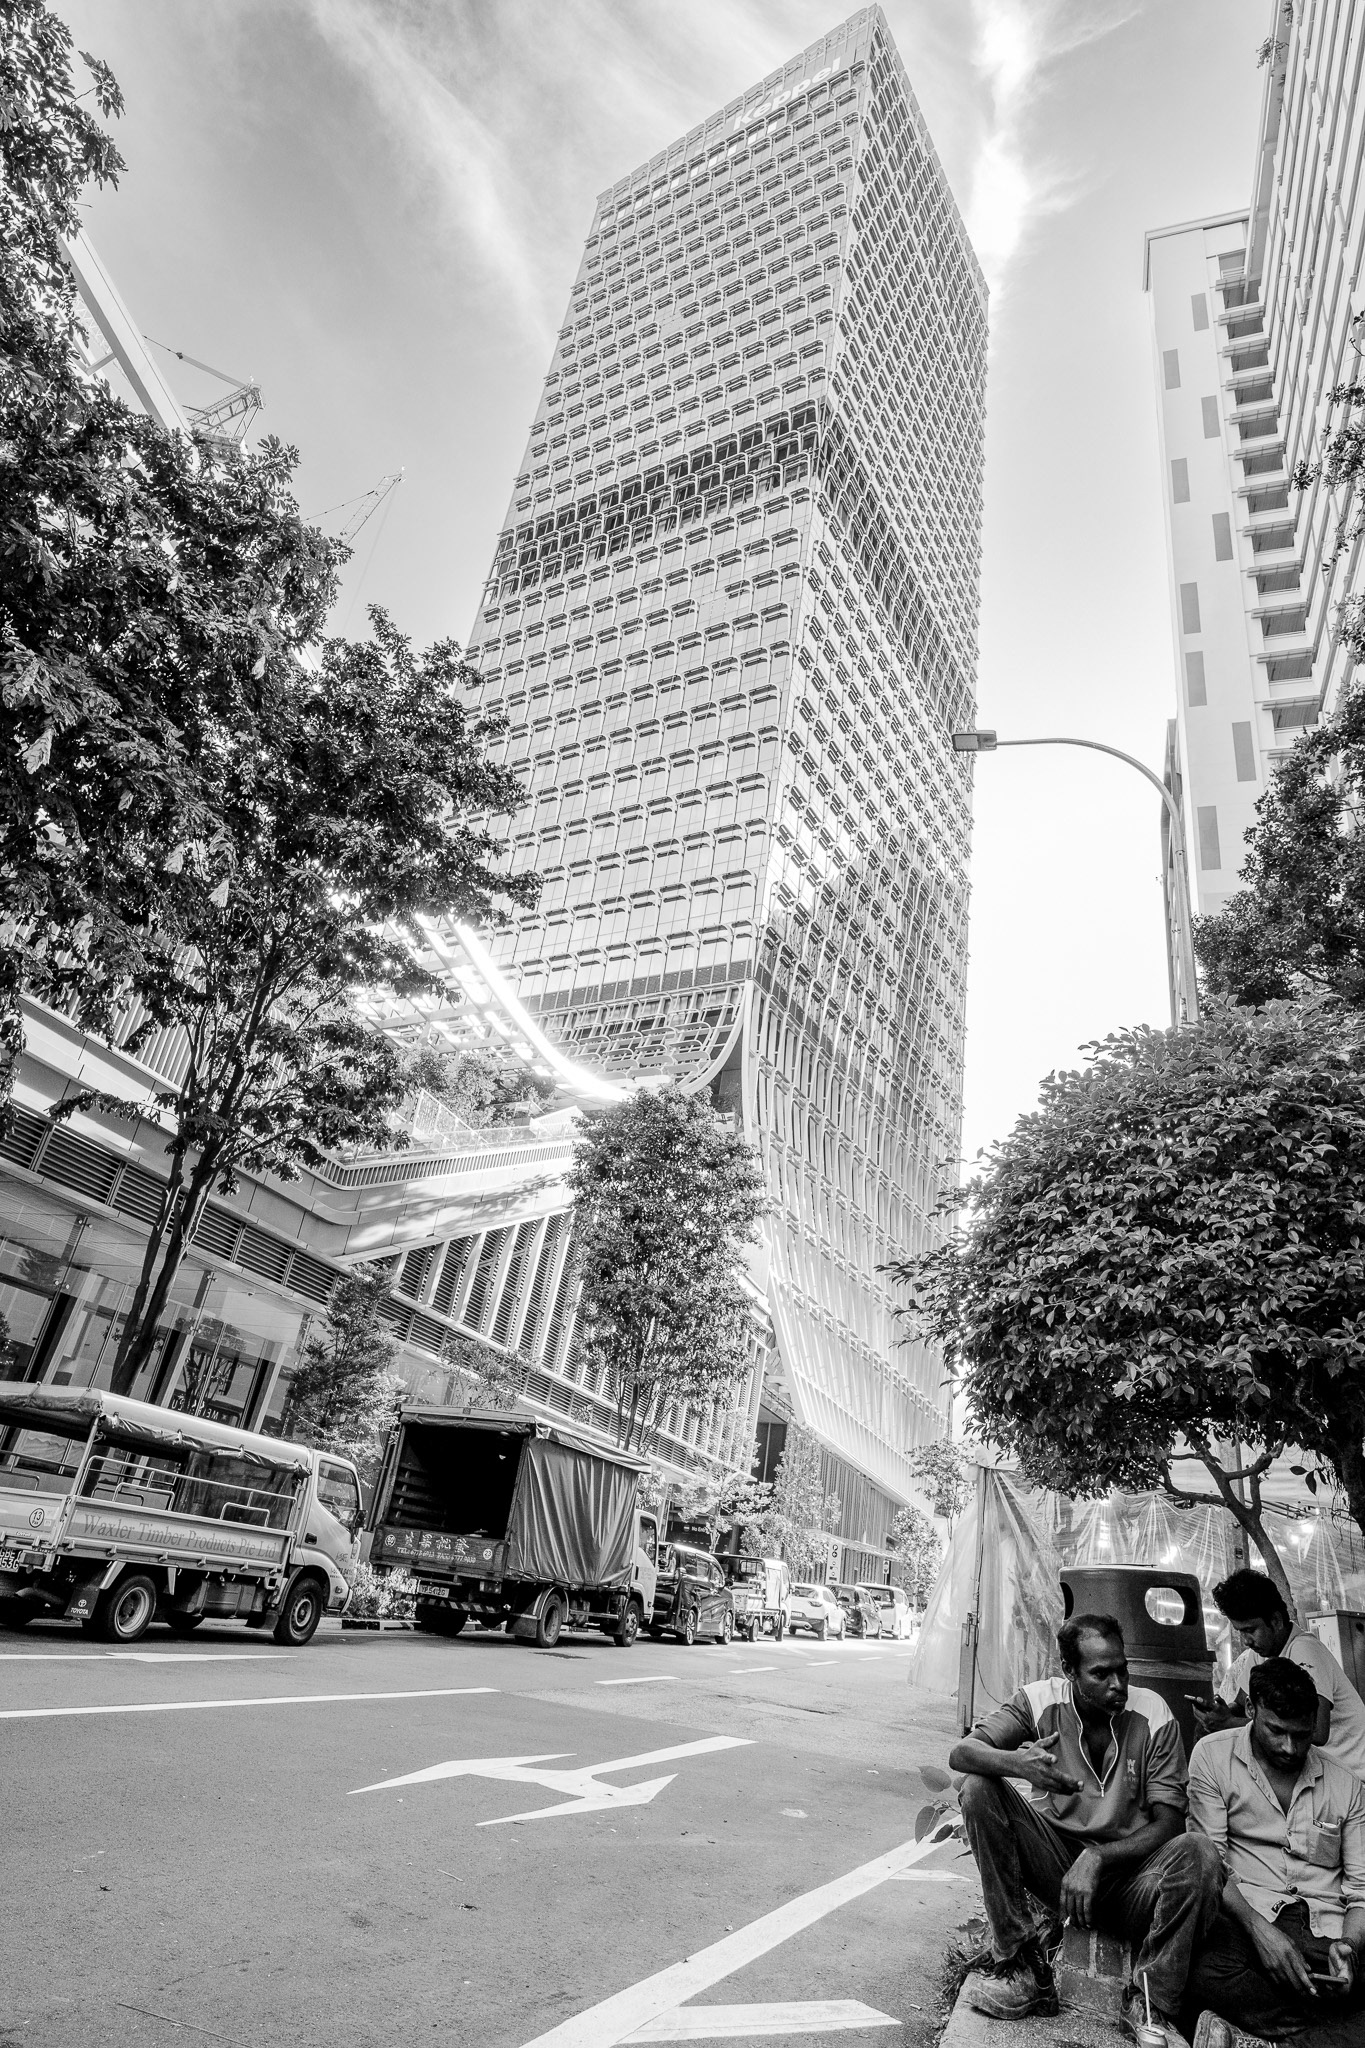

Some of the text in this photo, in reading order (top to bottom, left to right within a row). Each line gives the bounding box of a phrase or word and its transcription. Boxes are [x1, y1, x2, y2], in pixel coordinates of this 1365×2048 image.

[733, 57, 841, 131] Keppel
[33, 1511, 43, 1521] 13
[84, 1514, 277, 1558] Waxler Timber Products Pte Ltd
[0, 1557, 20, 1570] 53G
[71, 1607, 89, 1615] TOYOTA
